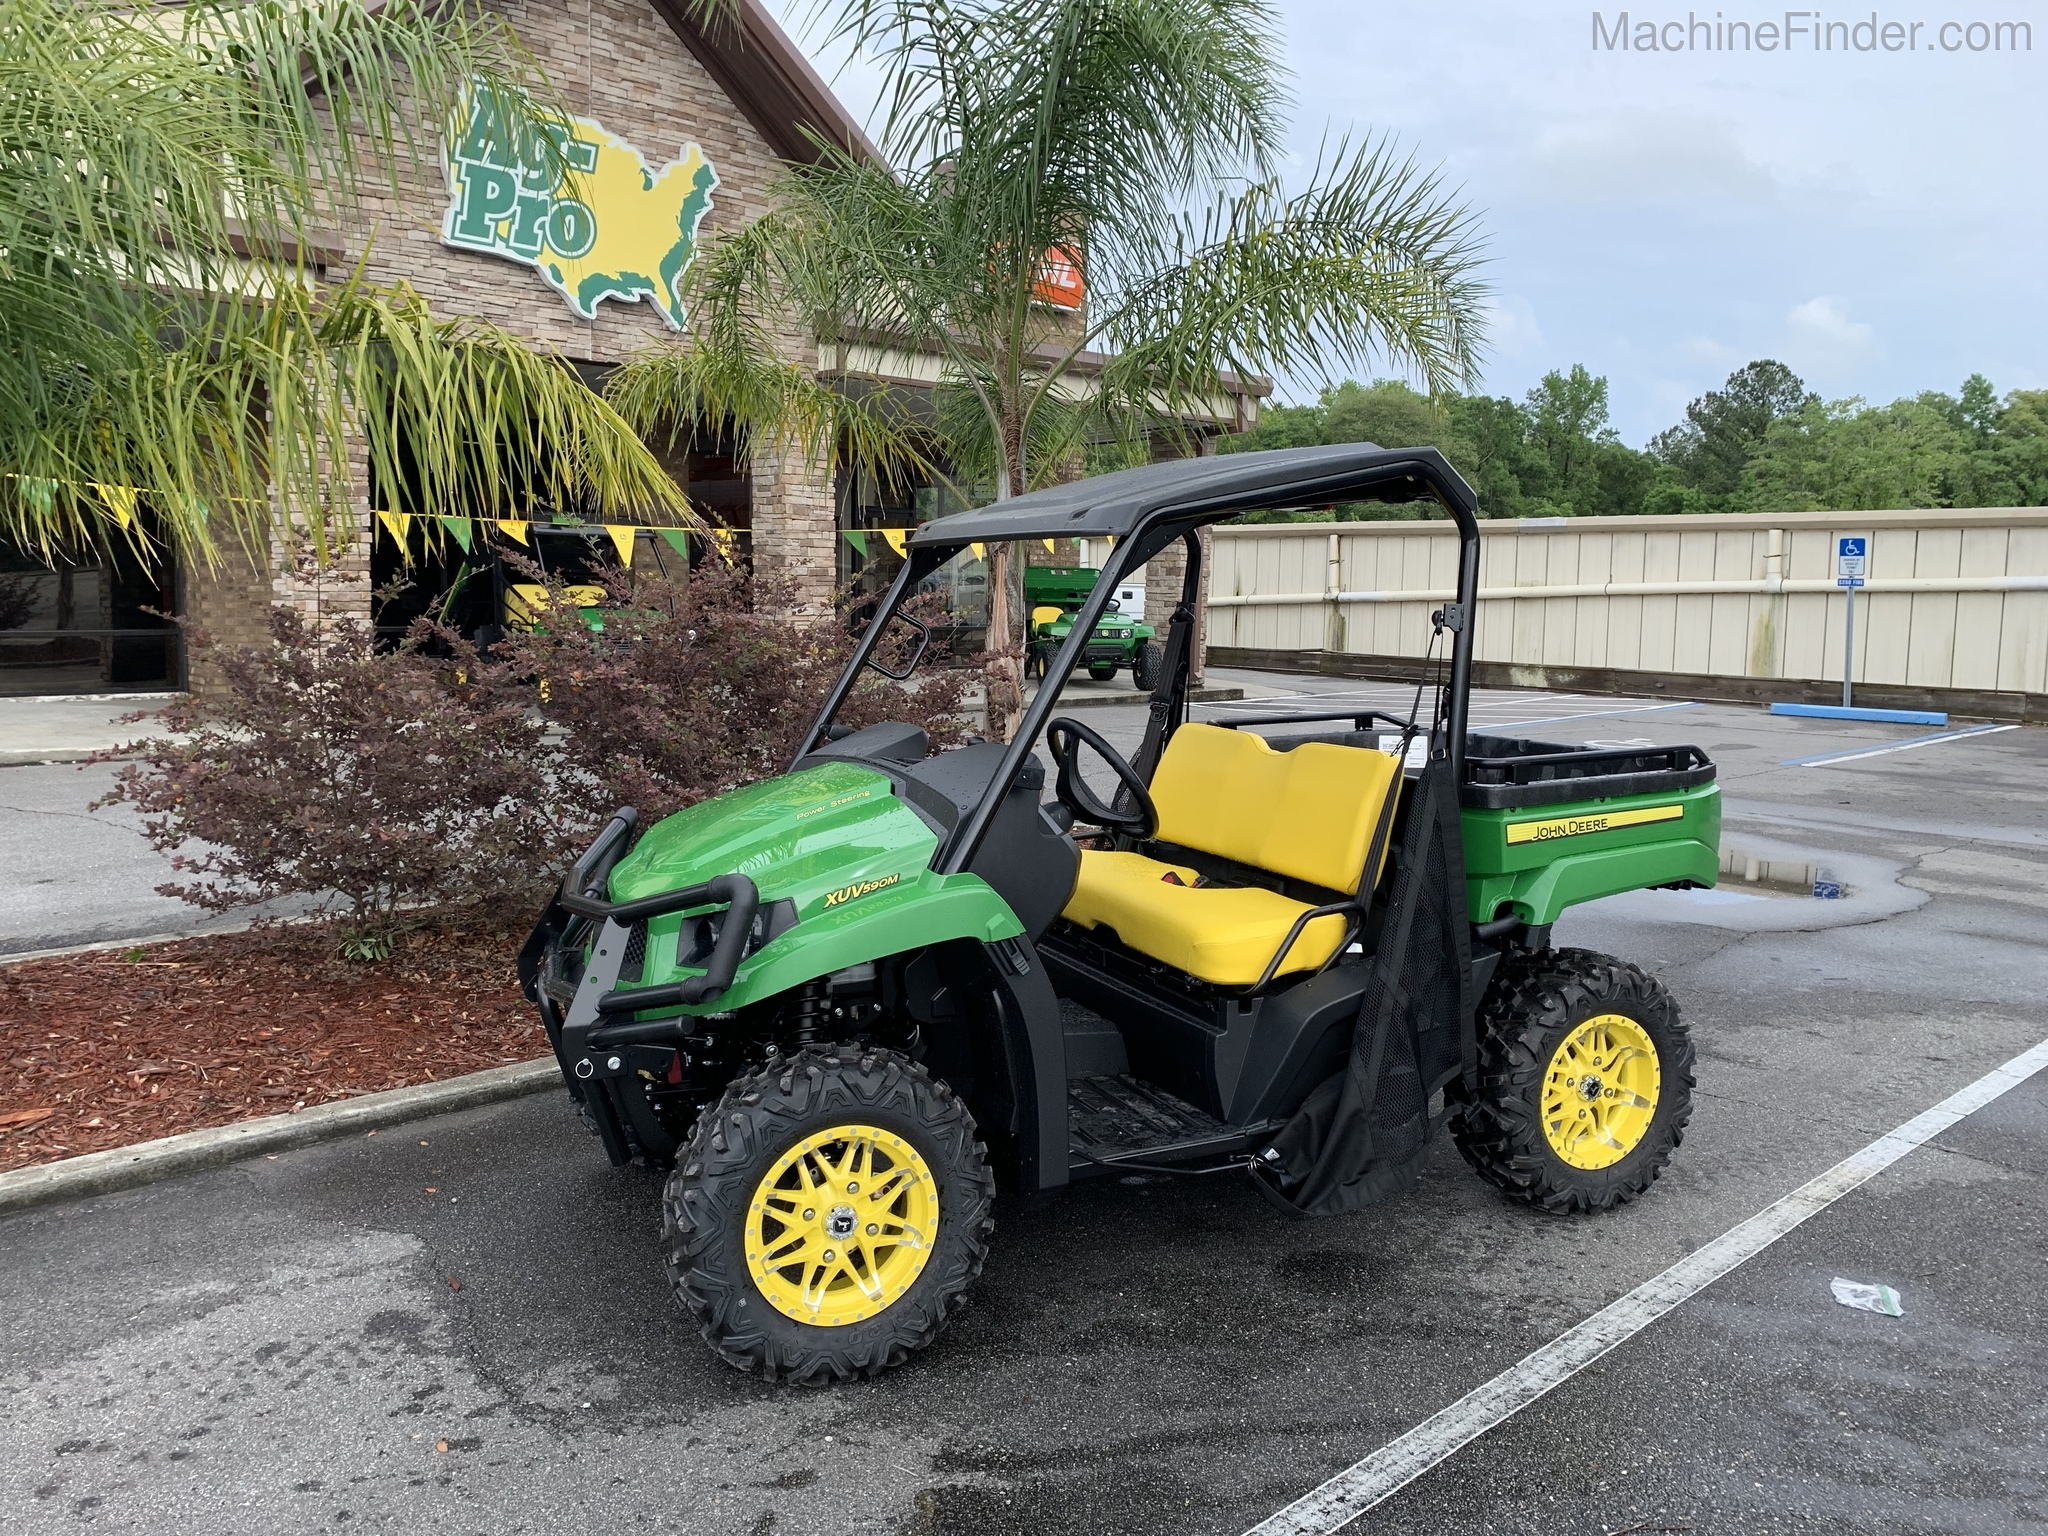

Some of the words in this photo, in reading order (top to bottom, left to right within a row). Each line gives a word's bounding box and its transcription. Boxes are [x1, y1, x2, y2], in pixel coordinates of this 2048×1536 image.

[449, 162, 598, 259] Pro
[796, 804, 827, 821] Power
[830, 790, 871, 808] Steering
[1533, 825, 1566, 840] JOHN
[1568, 818, 1609, 834] DEERE
[823, 873, 900, 909] XUV590M
